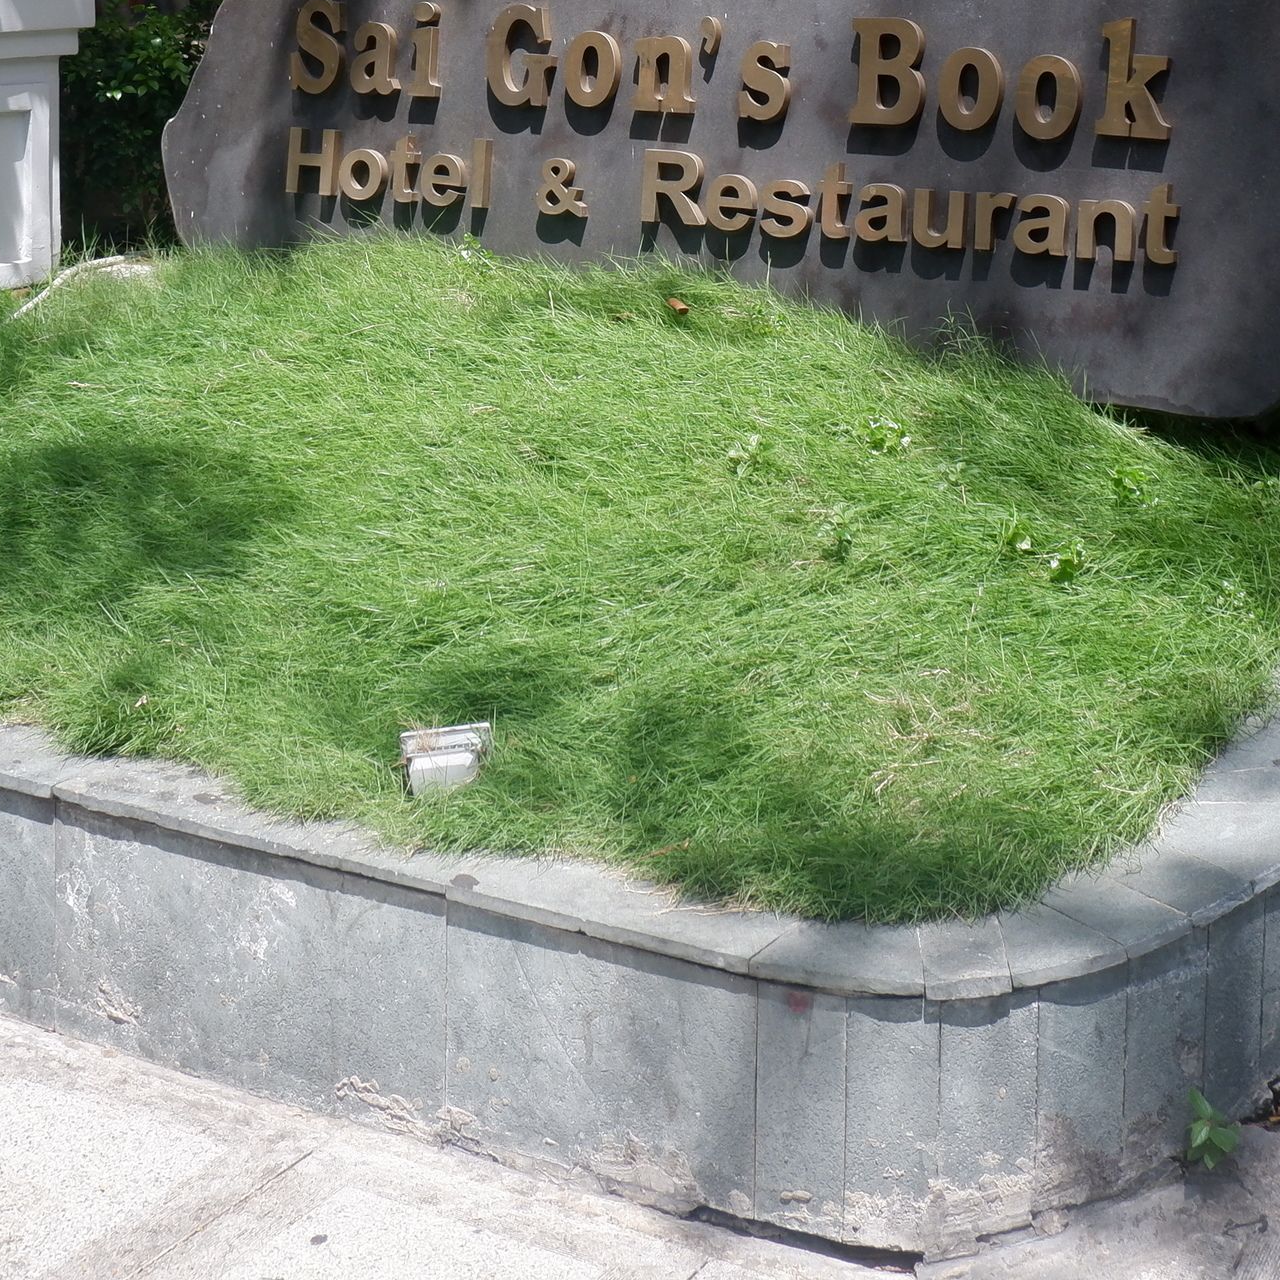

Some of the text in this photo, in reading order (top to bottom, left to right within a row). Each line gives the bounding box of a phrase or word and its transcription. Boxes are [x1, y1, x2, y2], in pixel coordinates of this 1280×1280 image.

[486, 2, 792, 120] Gon's
[848, 16, 1174, 141] Book
[285, 126, 1181, 266] Hotel & Restaurant
